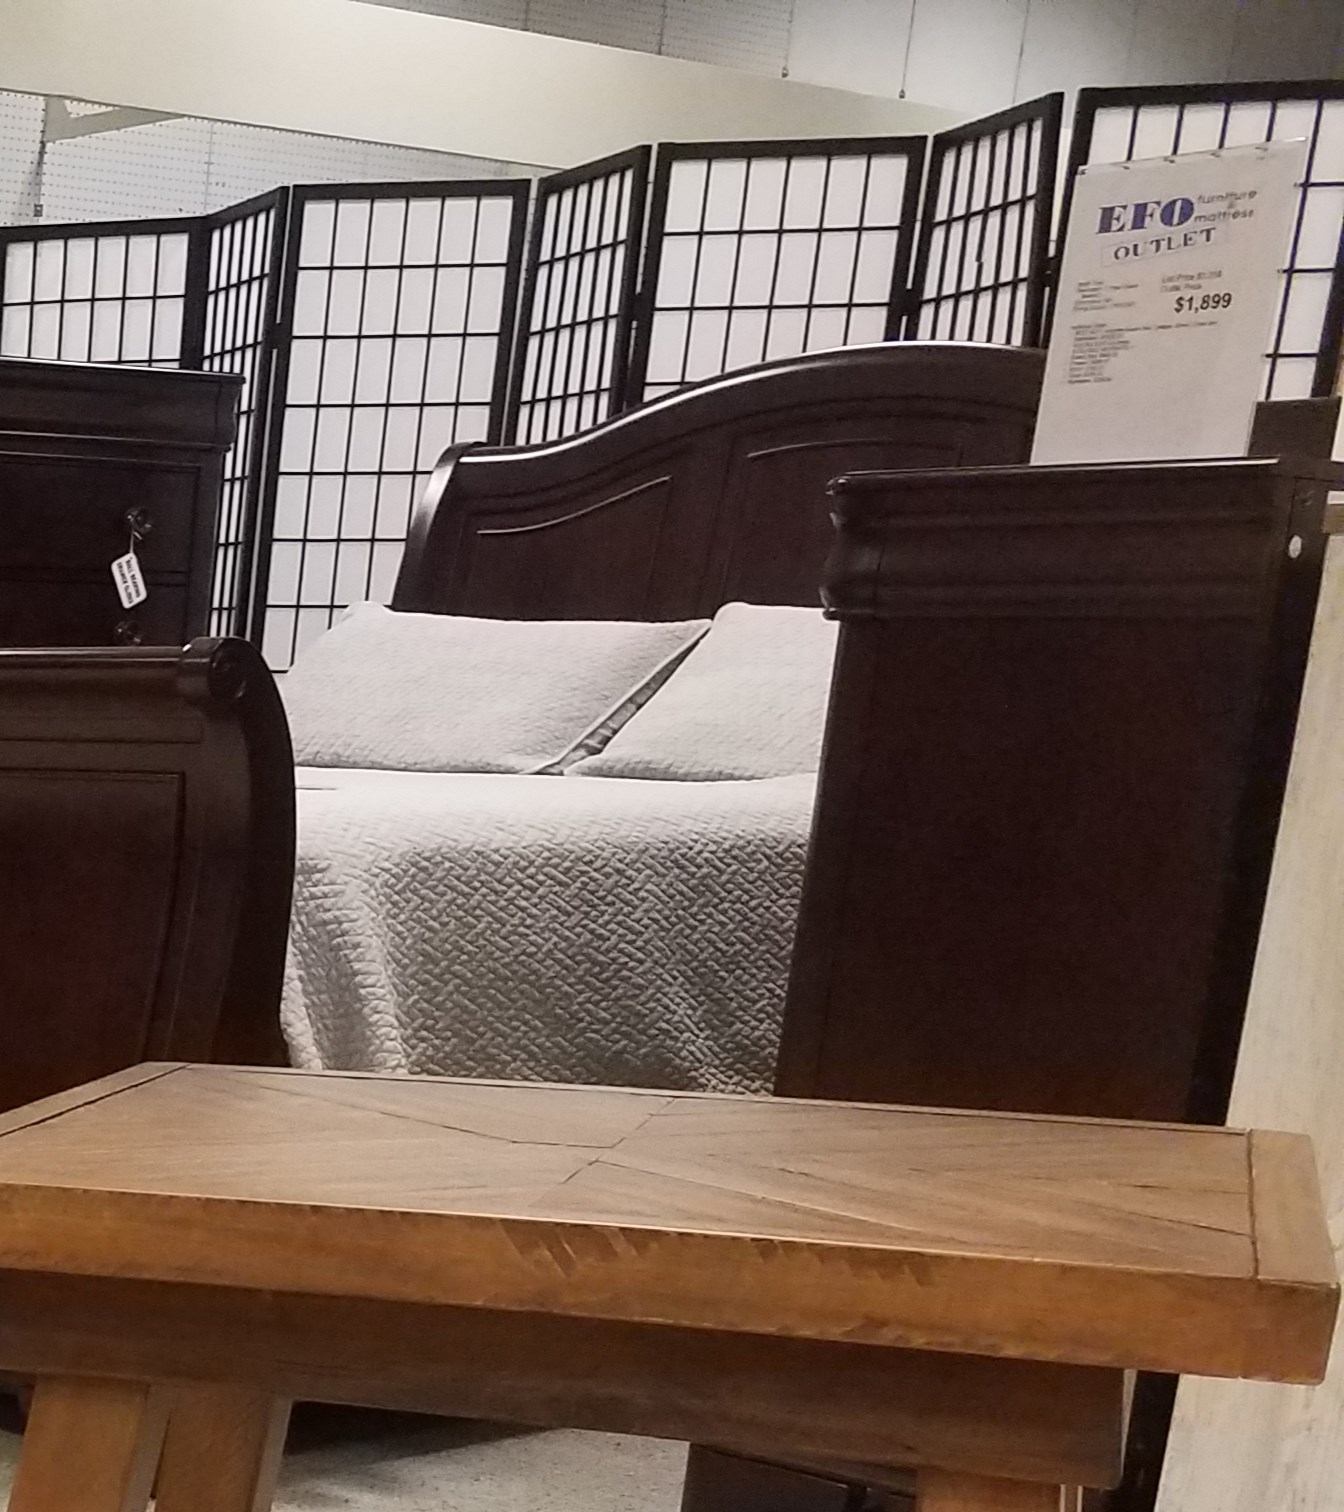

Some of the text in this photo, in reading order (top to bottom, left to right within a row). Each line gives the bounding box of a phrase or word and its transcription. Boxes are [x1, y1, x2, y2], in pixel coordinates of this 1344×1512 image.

[1096, 197, 1195, 234] EFO
[1114, 226, 1217, 261] OUTLET
[1174, 292, 1233, 314] $1,899
